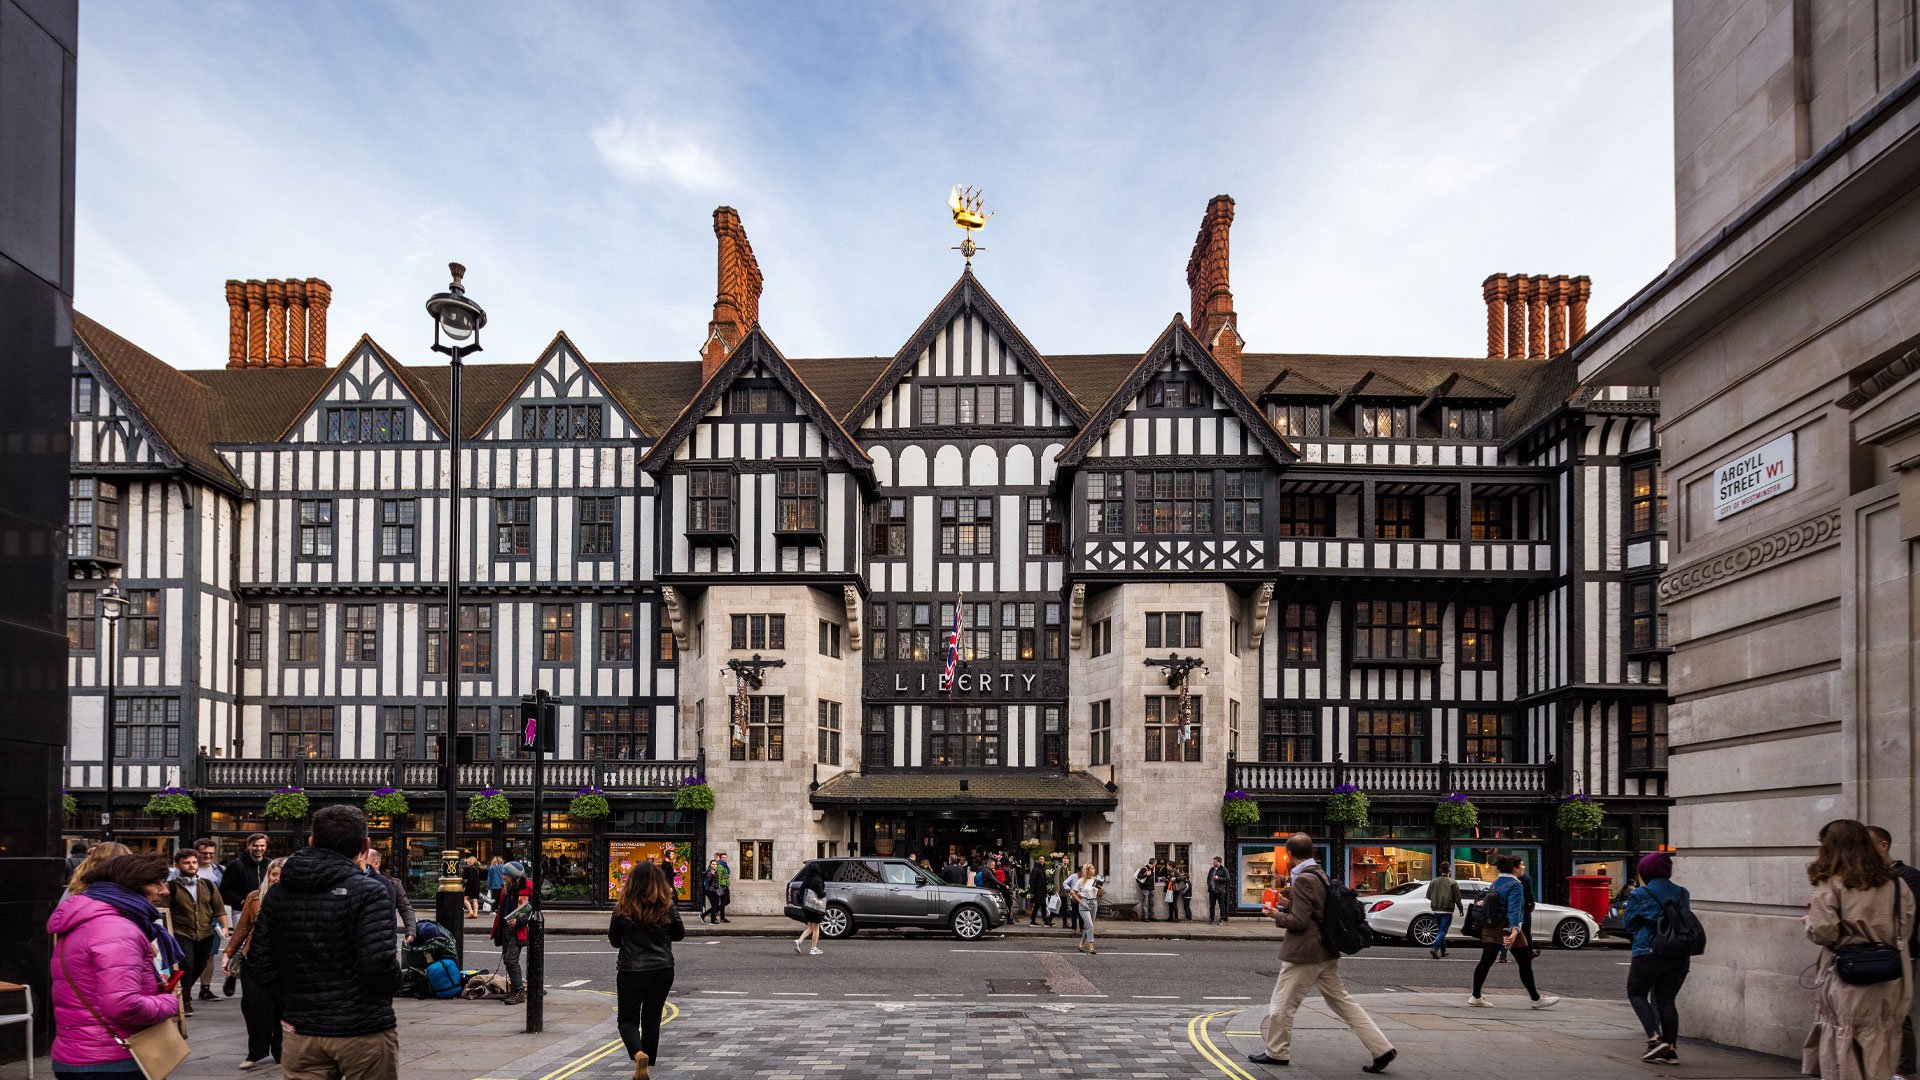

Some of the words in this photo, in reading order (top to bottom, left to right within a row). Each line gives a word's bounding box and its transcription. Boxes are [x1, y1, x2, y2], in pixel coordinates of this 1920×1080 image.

[1720, 453, 1764, 485] ARGYLL
[1720, 469, 1761, 500] STREET
[1766, 459, 1783, 478] W1
[1720, 503, 1733, 515] CITY
[1733, 499, 1740, 509] OF
[1741, 483, 1781, 505] WESTMINSTER
